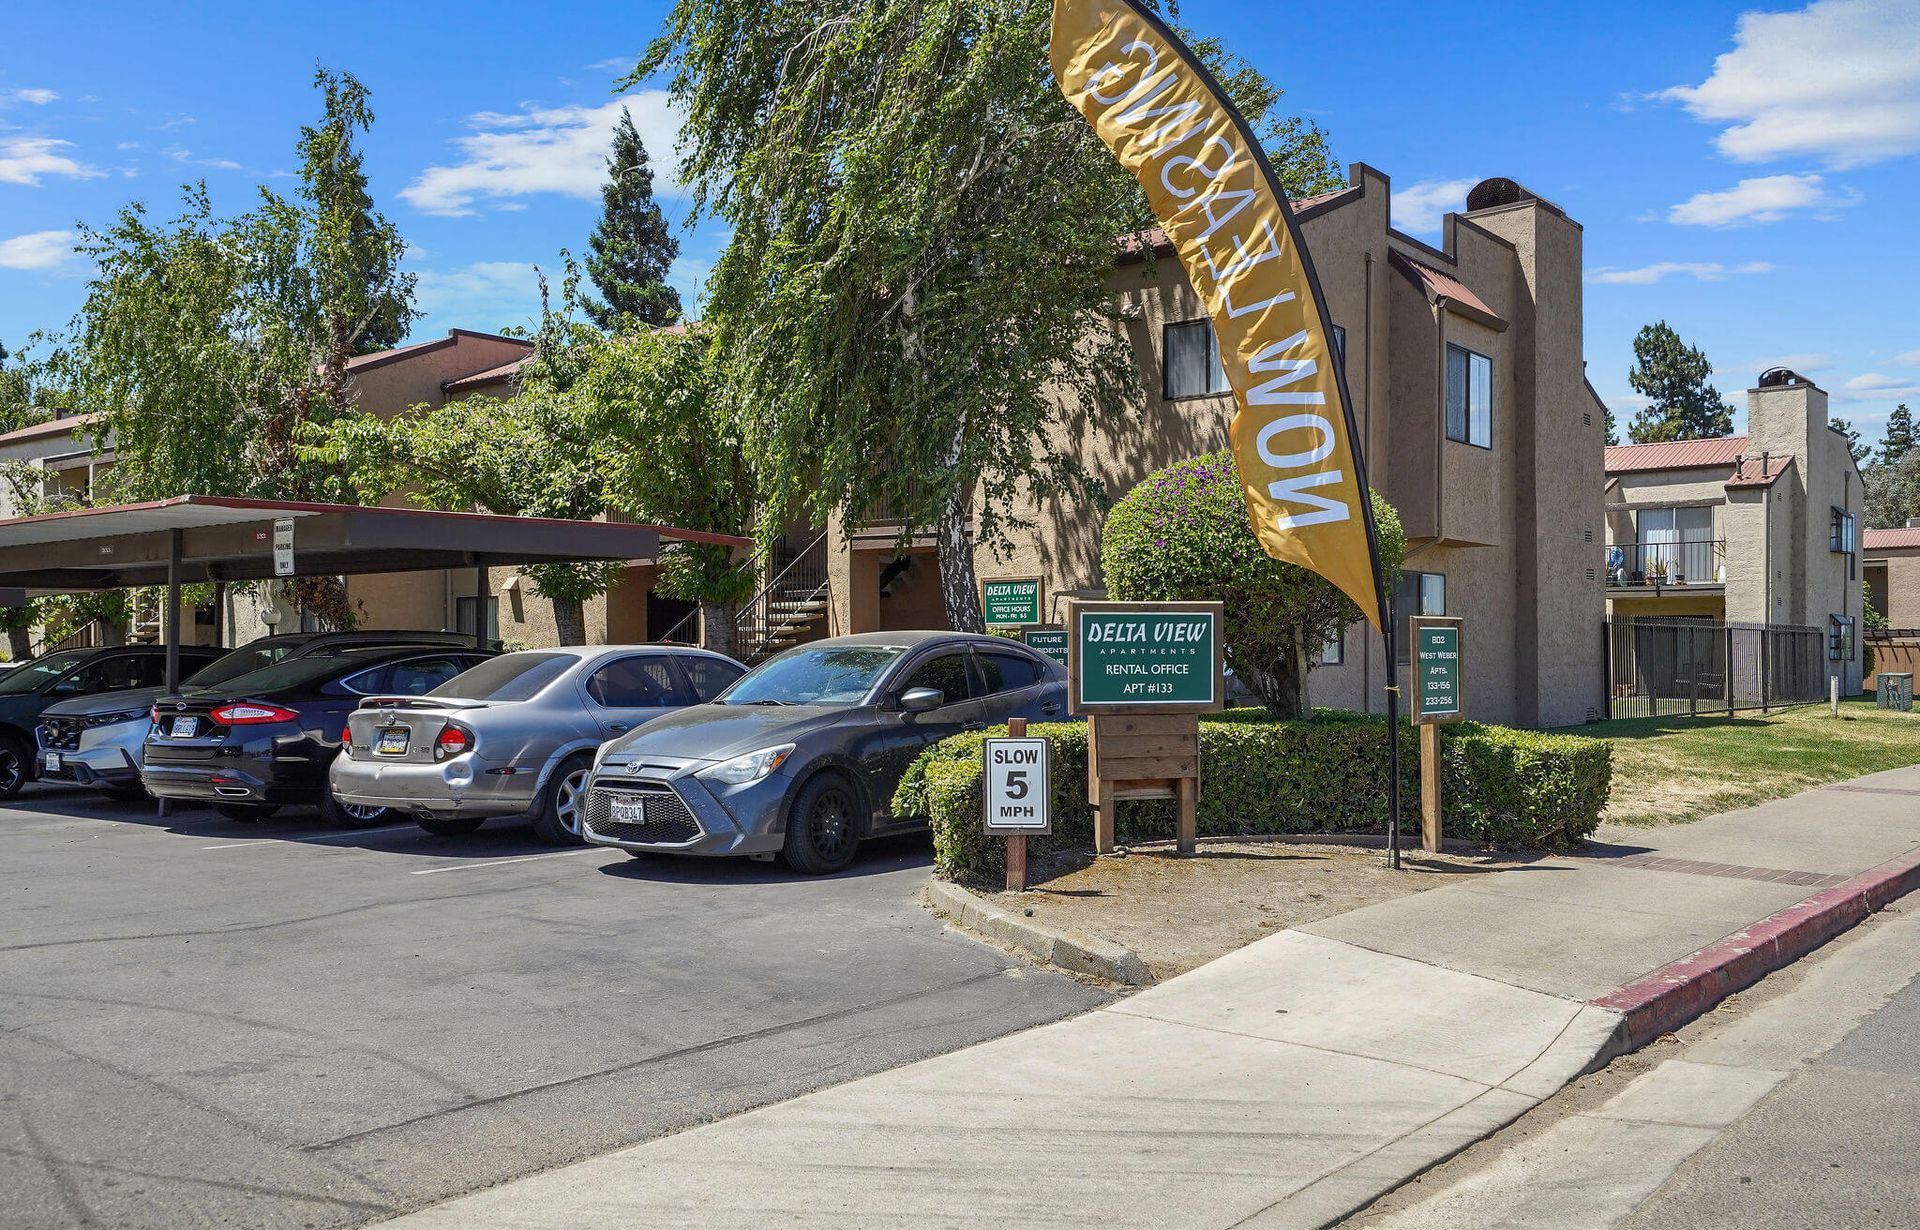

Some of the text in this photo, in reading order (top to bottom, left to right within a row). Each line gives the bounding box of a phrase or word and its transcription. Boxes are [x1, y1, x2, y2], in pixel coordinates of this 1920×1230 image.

[987, 584, 1036, 596] DELTA VIEW
[992, 605, 1010, 613] OFFICE
[1087, 622, 1207, 642] DELTA VIEW
[1106, 664, 1189, 675] RENTAL OFFICE
[1123, 683, 1173, 694] APT #133
[1427, 681, 1451, 690] 133-156
[1425, 696, 1453, 706] 233-256
[994, 749, 1038, 764] SLOW
[1005, 771, 1029, 800] 5
[1000, 806, 1034, 817] MPH
